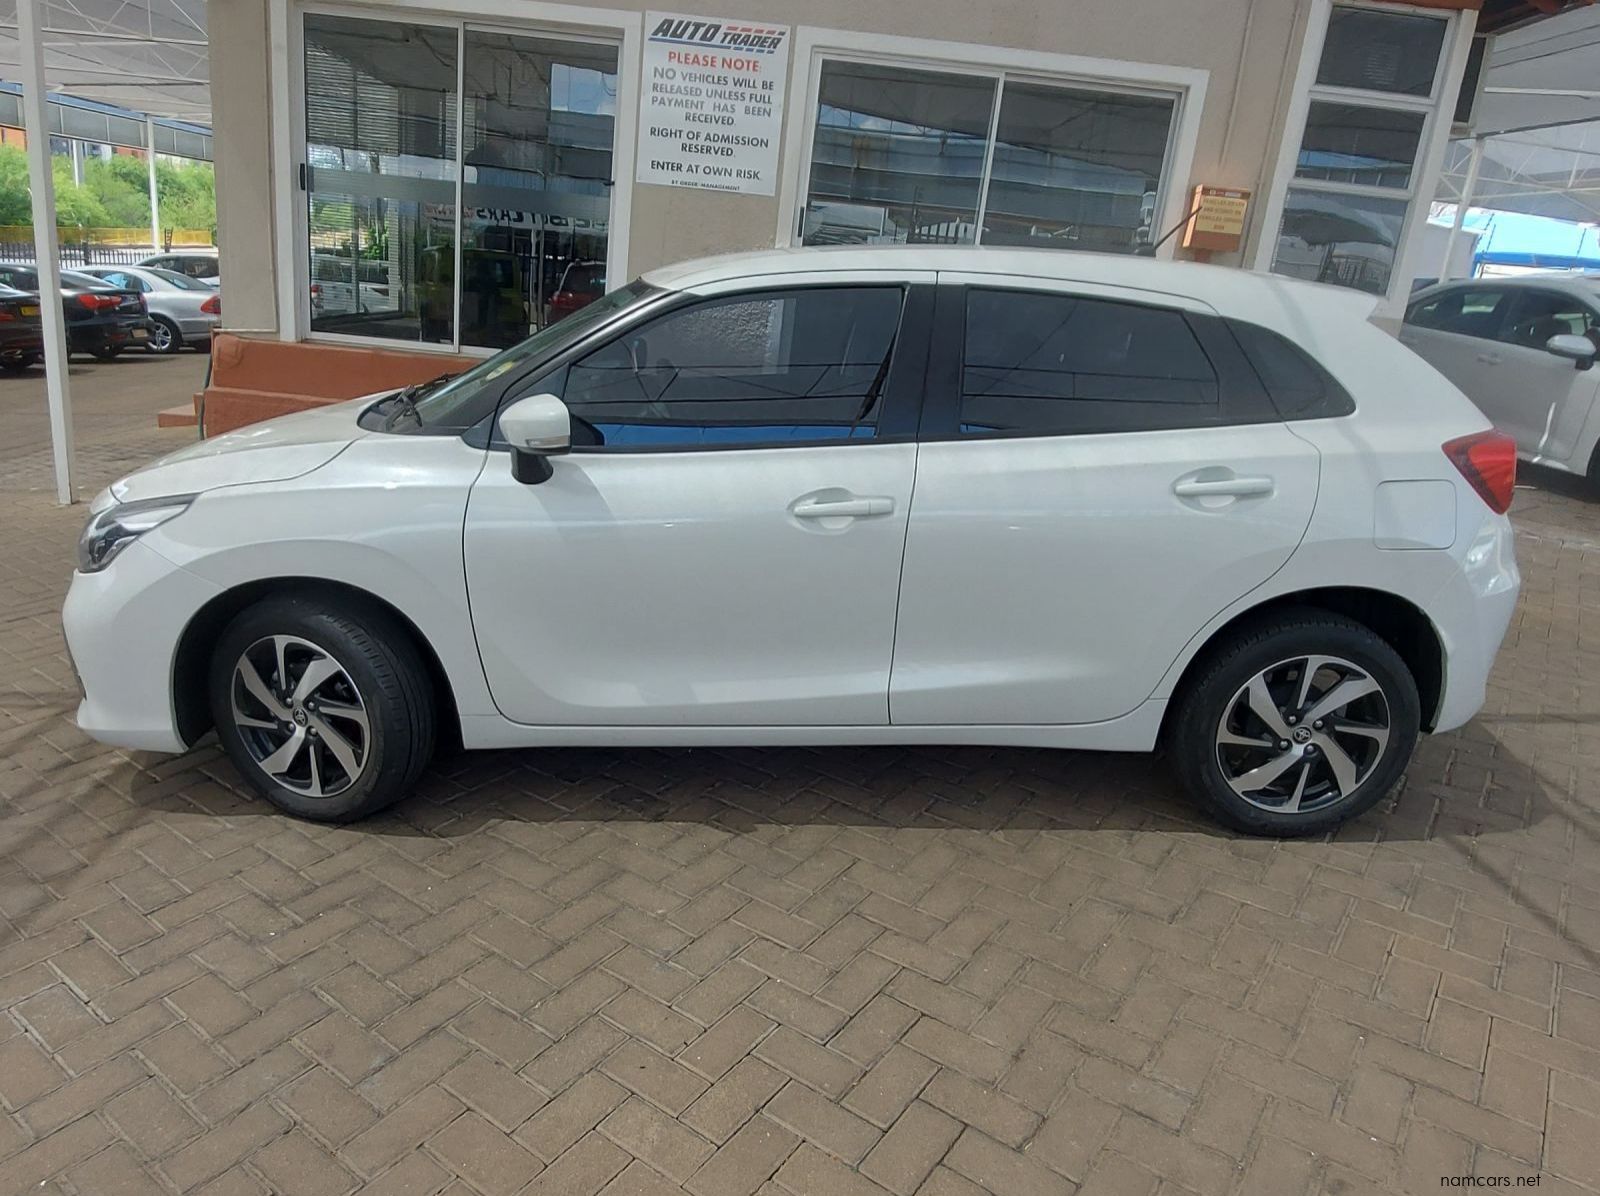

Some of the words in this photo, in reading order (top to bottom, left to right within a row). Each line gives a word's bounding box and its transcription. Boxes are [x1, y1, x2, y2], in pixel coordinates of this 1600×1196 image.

[652, 18, 722, 42] AUTO
[720, 32, 782, 49] TRADER
[668, 51, 718, 68] PLEASE
[653, 66, 677, 80] NO
[680, 71, 729, 86] VEHICLES
[732, 77, 757, 89] WILL
[761, 80, 774, 91] BE
[652, 82, 702, 97] RELEASED
[706, 88, 746, 101] UNLESS
[749, 92, 772, 104] FULL
[651, 96, 704, 110] PAYMENT
[713, 103, 736, 113] HAS
[744, 106, 771, 117] BEEN
[650, 127, 683, 139] RIGHT
[686, 131, 701, 141] OF
[704, 133, 769, 148] ADMISSION
[651, 160, 682, 172] ENTER
[686, 164, 700, 174] AT
[703, 166, 732, 177] OWN
